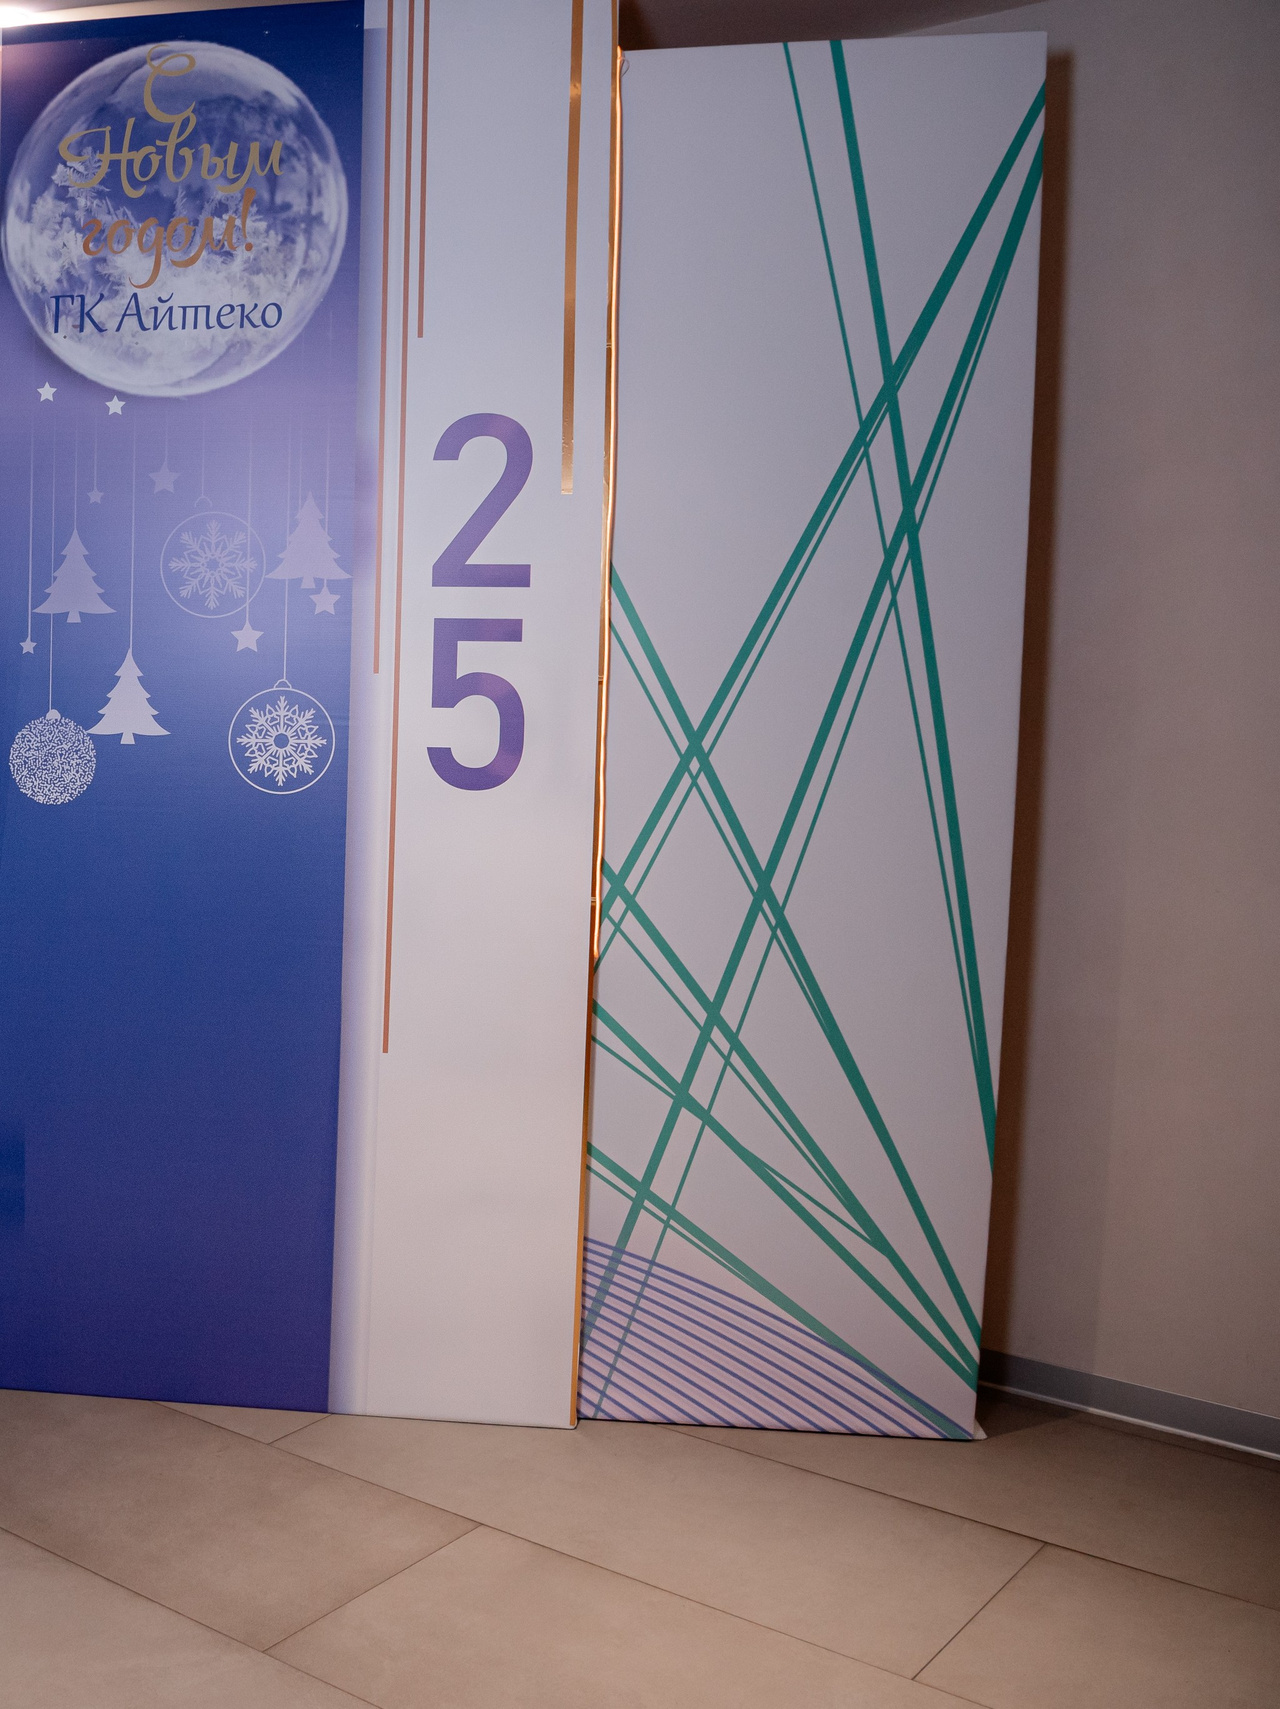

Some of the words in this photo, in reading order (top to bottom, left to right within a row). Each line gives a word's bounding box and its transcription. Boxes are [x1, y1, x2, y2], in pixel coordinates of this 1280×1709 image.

[143, 44, 196, 123] С
[58, 109, 284, 198] Новым
[81, 188, 257, 289] годом!
[50, 293, 108, 334] ГК
[115, 292, 283, 332] Айтеко
